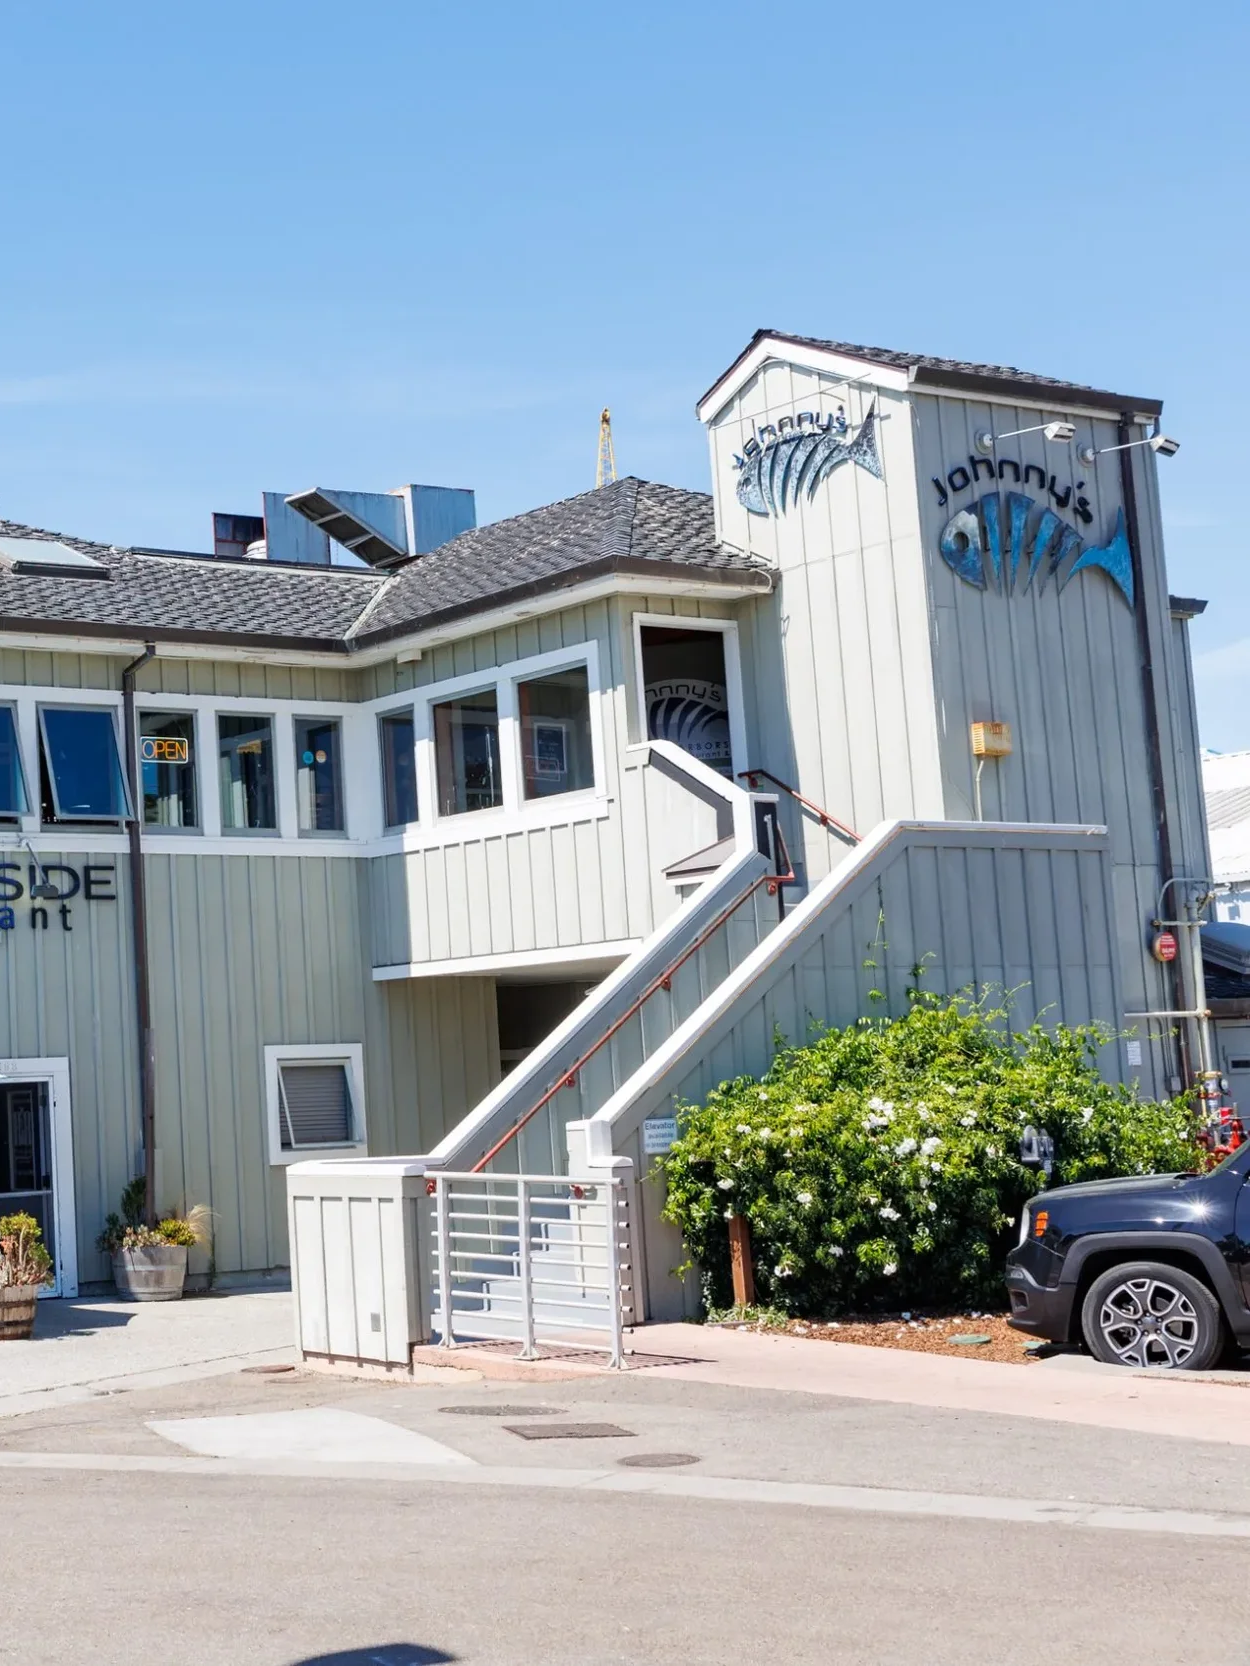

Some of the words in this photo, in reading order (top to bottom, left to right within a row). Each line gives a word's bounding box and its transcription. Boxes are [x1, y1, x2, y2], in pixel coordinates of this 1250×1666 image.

[932, 456, 1093, 524] Johnny's
[142, 740, 186, 760] OPEN
[644, 1121, 675, 1130] Elevator
